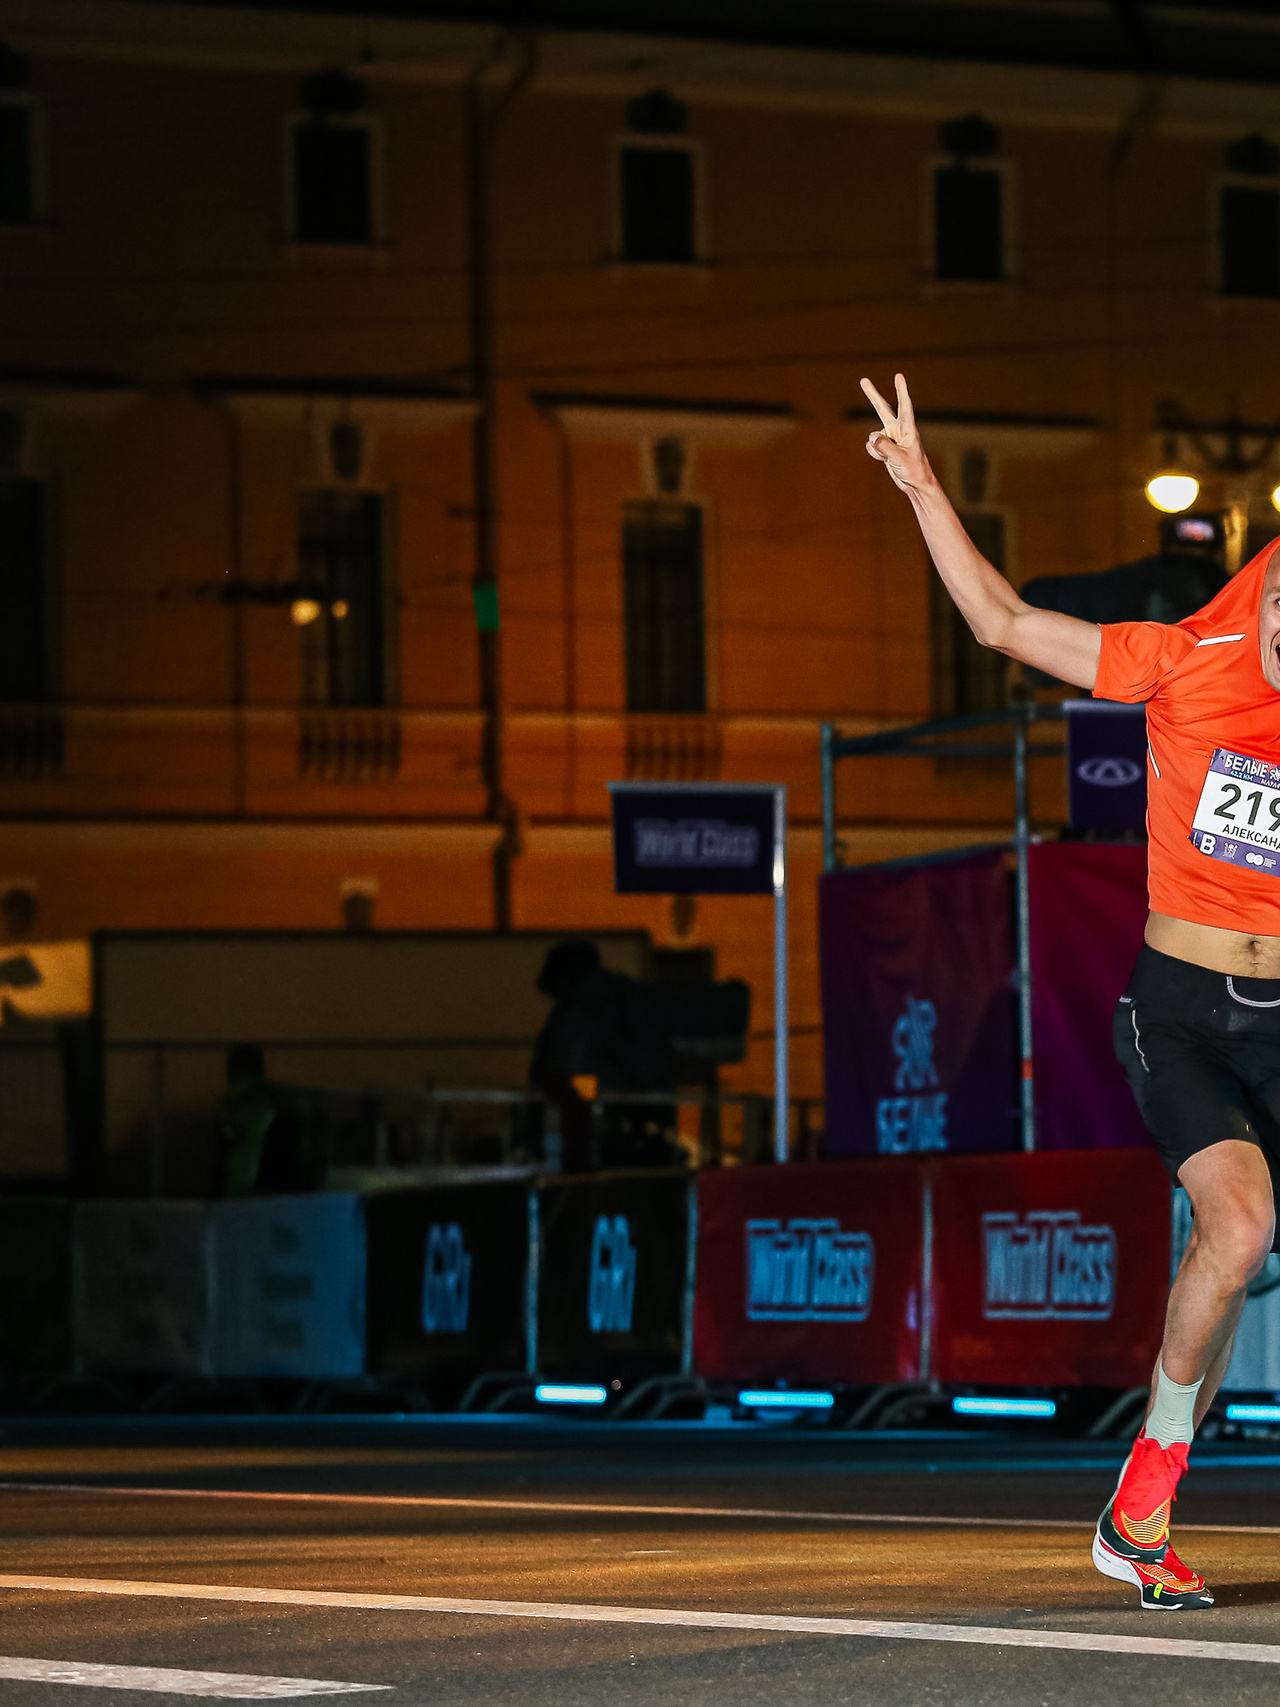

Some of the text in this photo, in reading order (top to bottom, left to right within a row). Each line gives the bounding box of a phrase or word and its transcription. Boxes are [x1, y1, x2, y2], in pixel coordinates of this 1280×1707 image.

[1224, 754, 1269, 778] БЕЛЫЕ
[749, 1235, 870, 1304] World Class
[986, 1227, 1112, 1303] World Class
